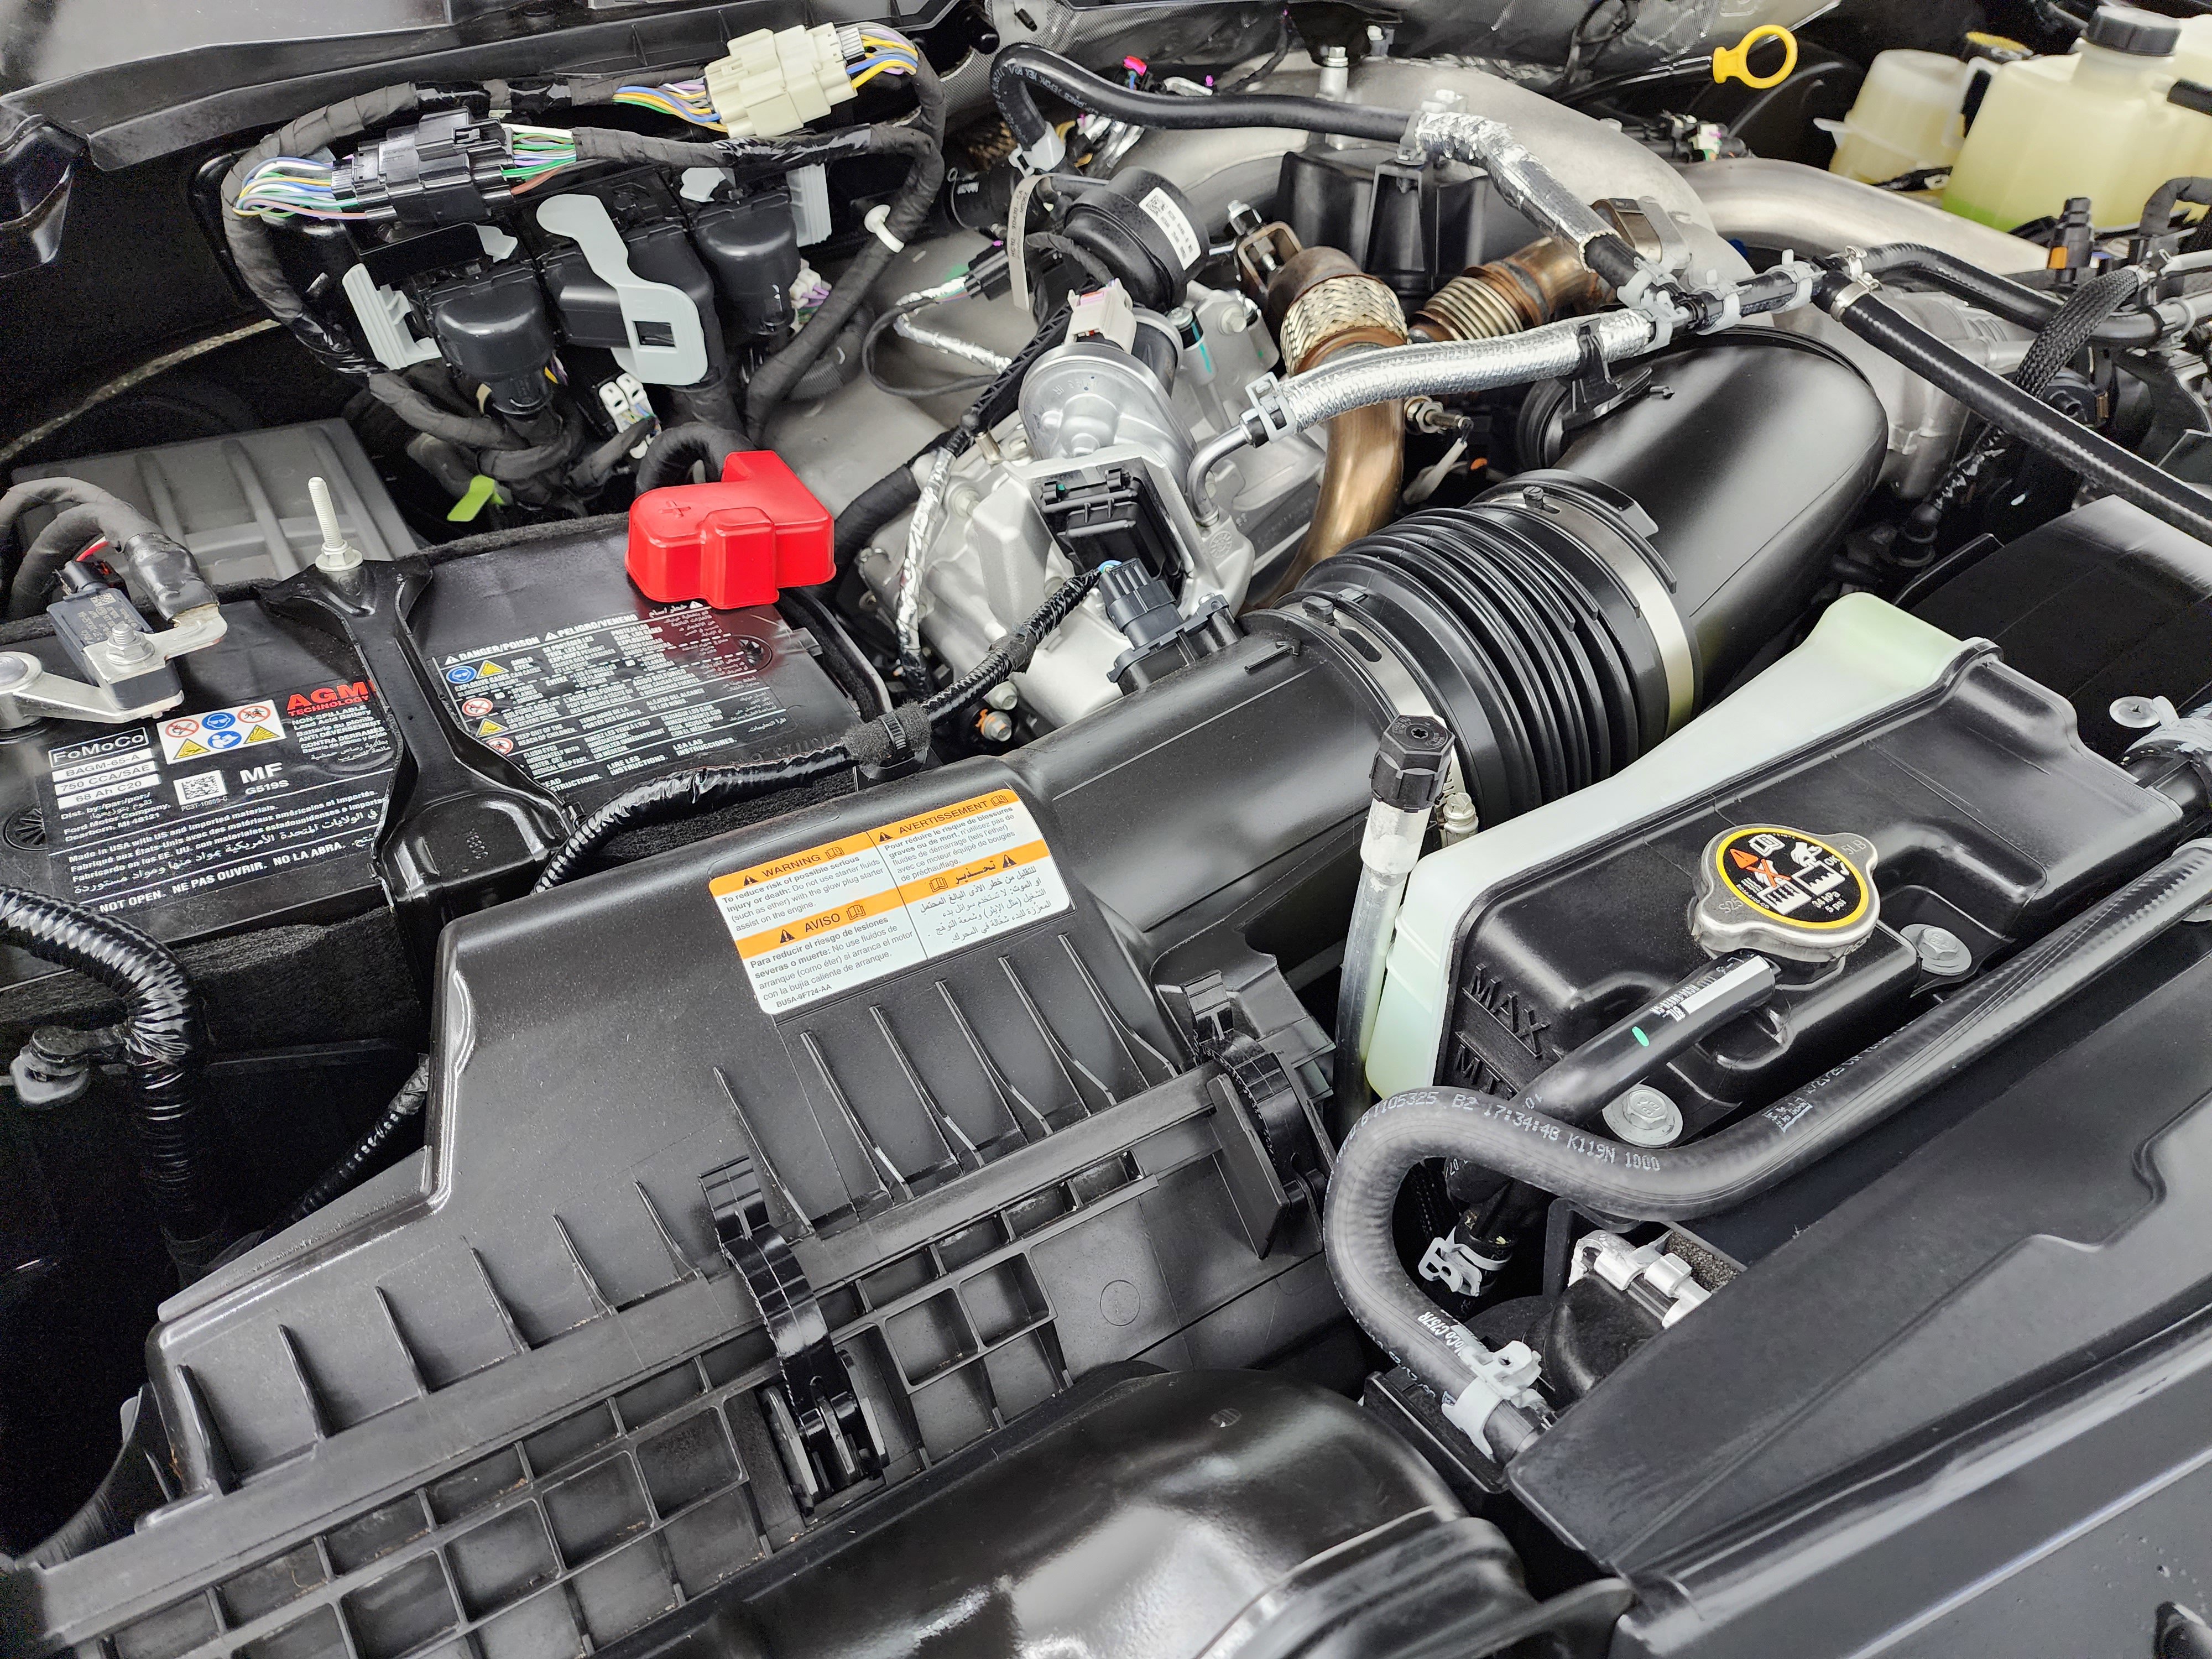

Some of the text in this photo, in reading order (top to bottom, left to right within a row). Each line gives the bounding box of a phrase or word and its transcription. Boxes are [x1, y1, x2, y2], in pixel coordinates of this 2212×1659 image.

[556, 613, 639, 638] PELIGRO/VENENO
[458, 635, 540, 661] DANGER/POISON
[286, 681, 368, 711] AGM
[287, 695, 369, 717] TECHNOLOGY
[52, 734, 144, 764] FoMoCo
[60, 764, 150, 791] 750 CCA/SAE
[65, 754, 140, 776] BAGM-65-A
[239, 761, 283, 784] MF
[609, 754, 669, 776] INSTRUCTIONS.
[75, 780, 142, 802] 68 Ah C20
[244, 779, 290, 796] G519S
[883, 841, 903, 851] Pour
[904, 832, 932, 844] réduire
[941, 822, 966, 833] risque
[976, 806, 1013, 821] blessures
[899, 800, 987, 834] AVERTISSEMENT
[888, 846, 916, 859] graves
[938, 831, 960, 842] mort,
[990, 817, 1005, 827] pas
[891, 854, 917, 866] fluides
[928, 837, 967, 854] démarrage
[967, 832, 984, 842] (tels
[1840, 839, 1867, 855] 5LB
[761, 854, 821, 877] WARNING
[896, 863, 915, 874] avec
[926, 851, 951, 864] moteur
[952, 842, 977, 855] équipé
[987, 831, 1015, 844] bougies
[1824, 855, 1841, 867] OK
[98, 841, 346, 913] NOT OPEN. NE PAS OUVRIR. NO LA ABRA.
[734, 886, 765, 900] reduce
[765, 880, 783, 890] risk
[783, 876, 792, 884] of
[793, 866, 829, 883] possible
[829, 856, 860, 869] serious
[911, 858, 961, 880] préchauffage.
[726, 900, 751, 912] injury
[764, 888, 791, 900] death:
[805, 878, 819, 888] not
[818, 874, 834, 883] use
[834, 865, 859, 878] starter
[859, 859, 880, 869] fluids
[731, 910, 754, 923] (such
[766, 897, 790, 910] ether)
[790, 892, 808, 902] with
[807, 888, 822, 896] the
[822, 881, 841, 893] glow
[841, 876, 859, 887] plug
[859, 867, 884, 880] starter
[1812, 890, 1841, 909] 34 kPa
[735, 918, 760, 931] assist
[771, 910, 786, 919] the
[786, 901, 816, 915] engine.
[1825, 898, 1847, 913] 5 psi
[805, 912, 840, 932] AVISO
[749, 917, 889, 968] Para reducir el riesgo de lesiones
[754, 963, 789, 979] severas
[797, 948, 831, 964] muerte:
[831, 943, 844, 952] No
[844, 938, 860, 948] use
[860, 929, 886, 942] fluidos
[887, 925, 898, 933] de
[758, 930, 912, 990] arranque (como éter) si arranca el motor
[763, 990, 779, 1000] con
[810, 968, 842, 984] caliente
[842, 963, 854, 972] de
[854, 951, 892, 968] arranque.
[775, 983, 832, 1008] BU5A-9F724-AA
[1467, 962, 1552, 1058] MAX
